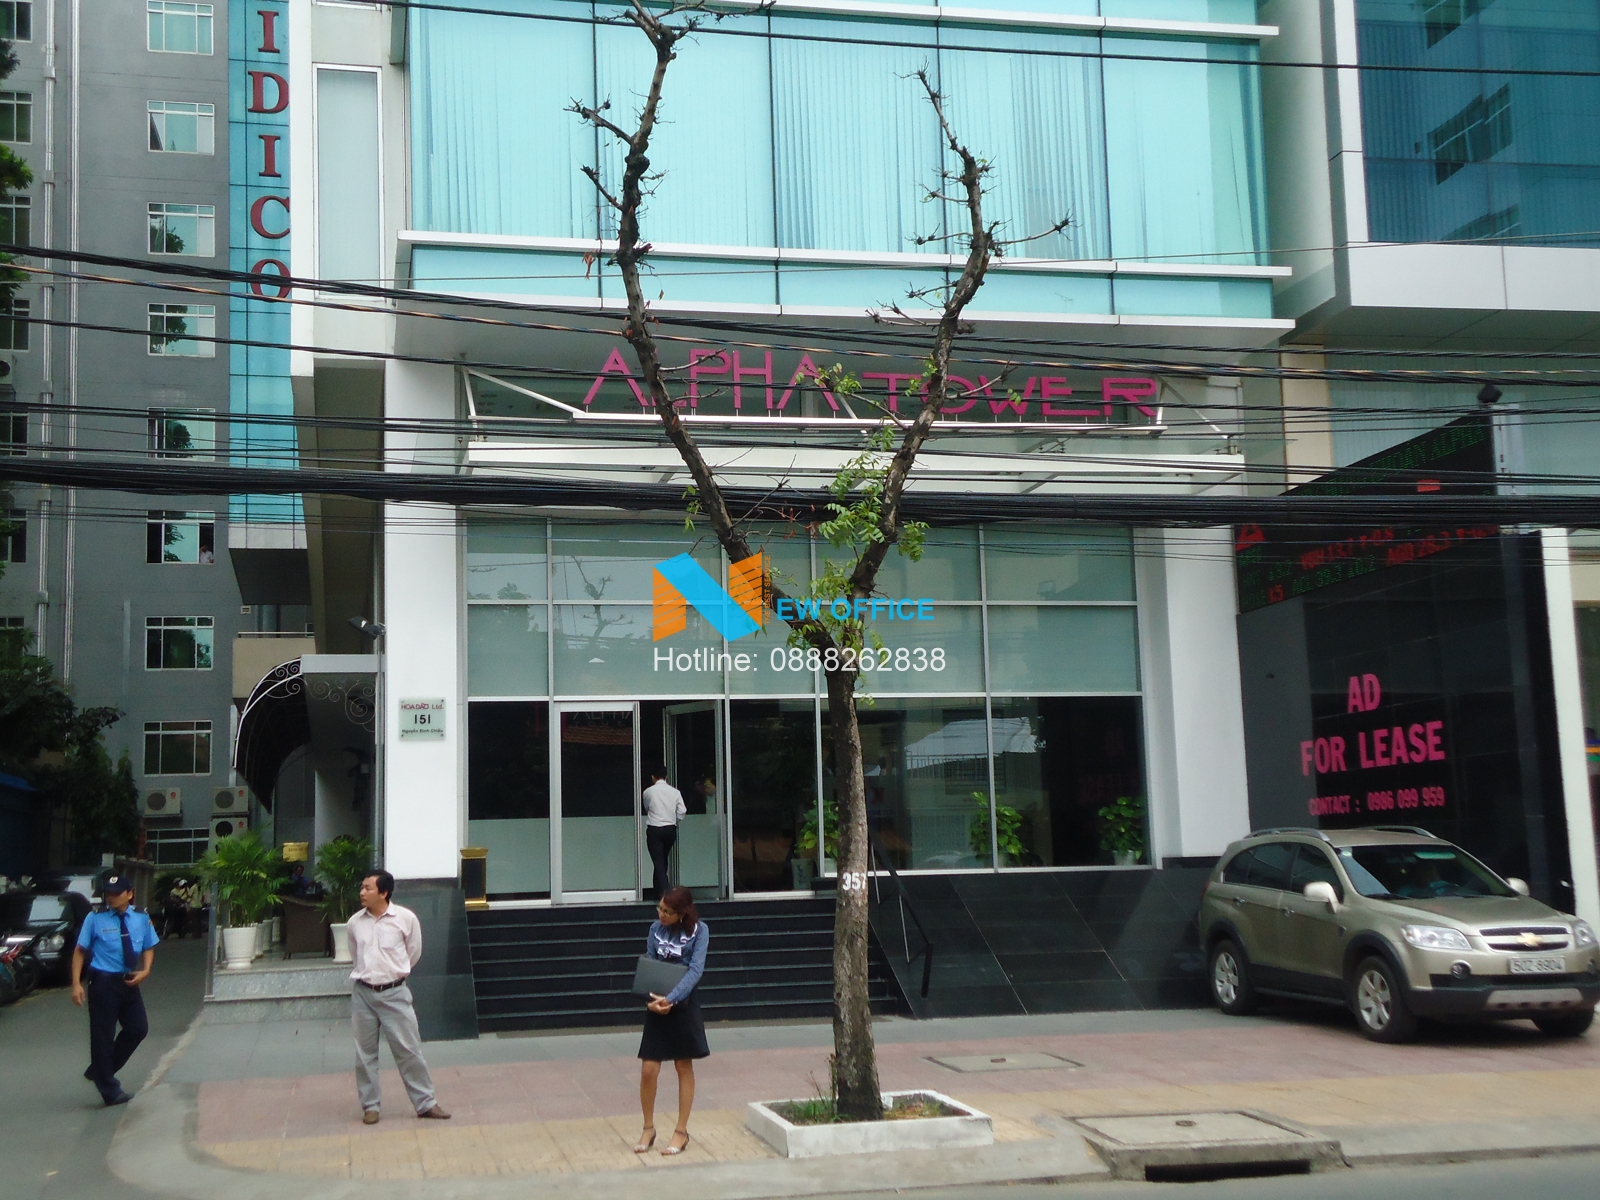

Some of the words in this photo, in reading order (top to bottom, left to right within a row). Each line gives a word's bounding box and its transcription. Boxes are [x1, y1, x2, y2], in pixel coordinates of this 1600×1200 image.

[247, 10, 291, 302] IDICO
[583, 346, 840, 411] APHA
[862, 372, 1158, 417] TOWER
[1347, 673, 1381, 714] AD
[414, 714, 431, 725] 151
[1301, 736, 1347, 776] FOR
[1358, 720, 1446, 769] LEASE
[1309, 795, 1350, 816] CONTACT
